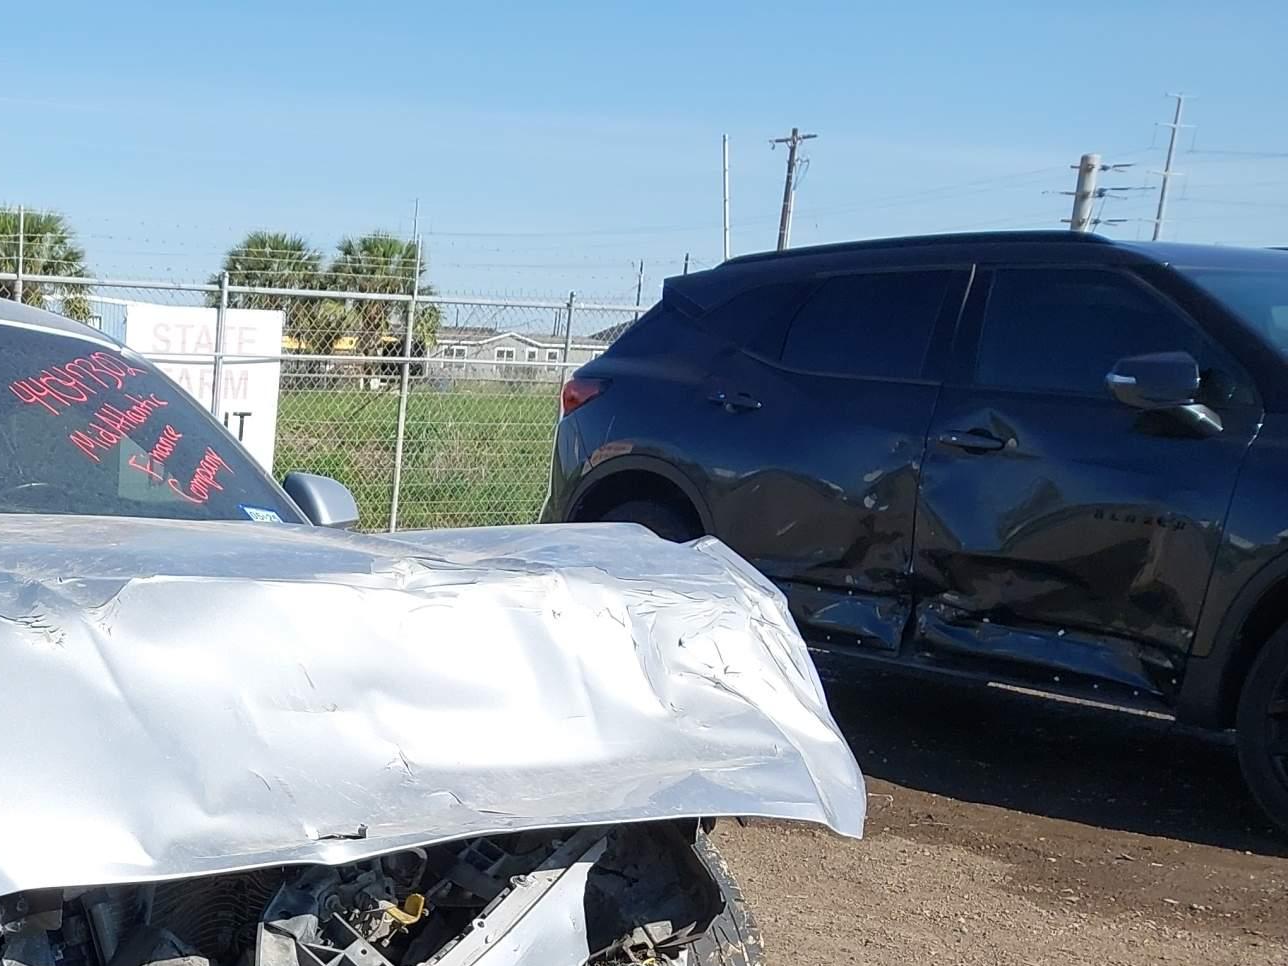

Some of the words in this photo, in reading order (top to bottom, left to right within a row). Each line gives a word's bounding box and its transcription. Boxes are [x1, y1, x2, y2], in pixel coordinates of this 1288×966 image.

[152, 322, 257, 356] STATE
[162, 368, 249, 400] ARM
[224, 411, 253, 443] IT
[168, 446, 234, 504] Company
